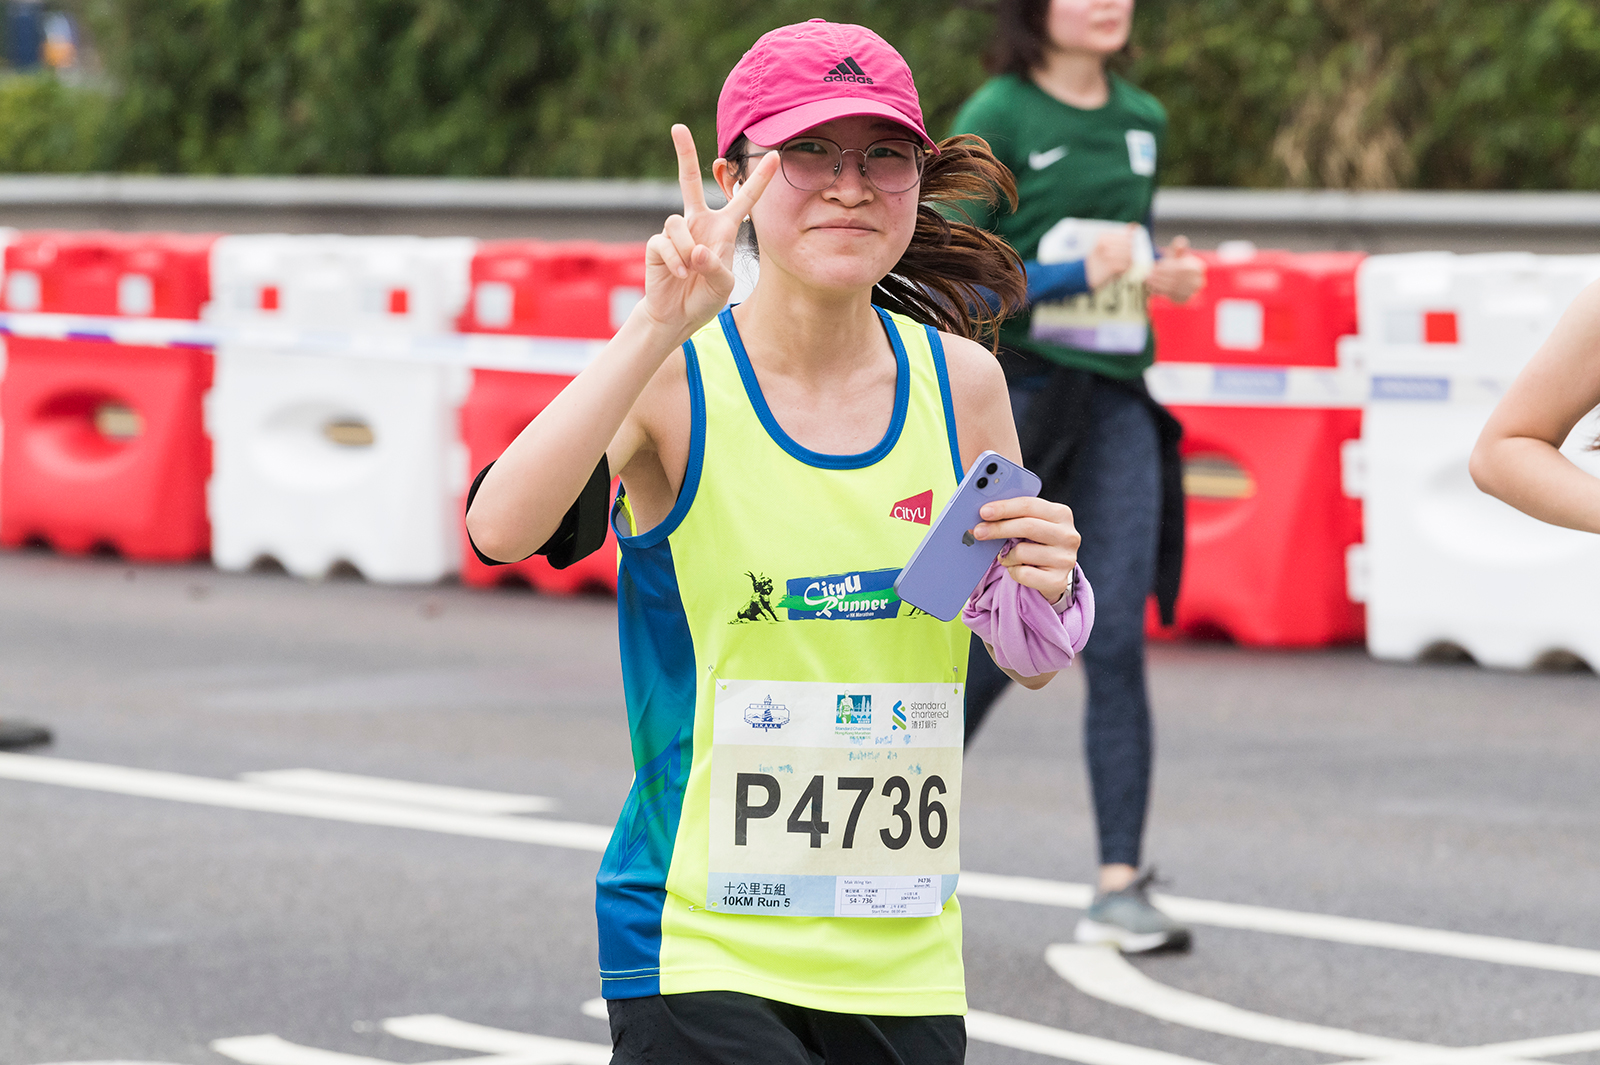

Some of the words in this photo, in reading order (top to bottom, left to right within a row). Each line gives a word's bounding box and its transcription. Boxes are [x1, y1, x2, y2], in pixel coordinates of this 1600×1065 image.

[823, 73, 874, 84] adidas
[893, 506, 926, 522] CityU
[804, 574, 862, 606] CityU
[815, 596, 889, 618] Runner
[910, 701, 947, 710] standard
[910, 710, 949, 719] chartered
[911, 720, 937, 729] 渣打銀行
[734, 772, 948, 850] P4736
[724, 881, 786, 896] 十公里五組
[722, 895, 753, 906] 10KM
[757, 897, 780, 907] Run
[783, 898, 791, 908] 5
